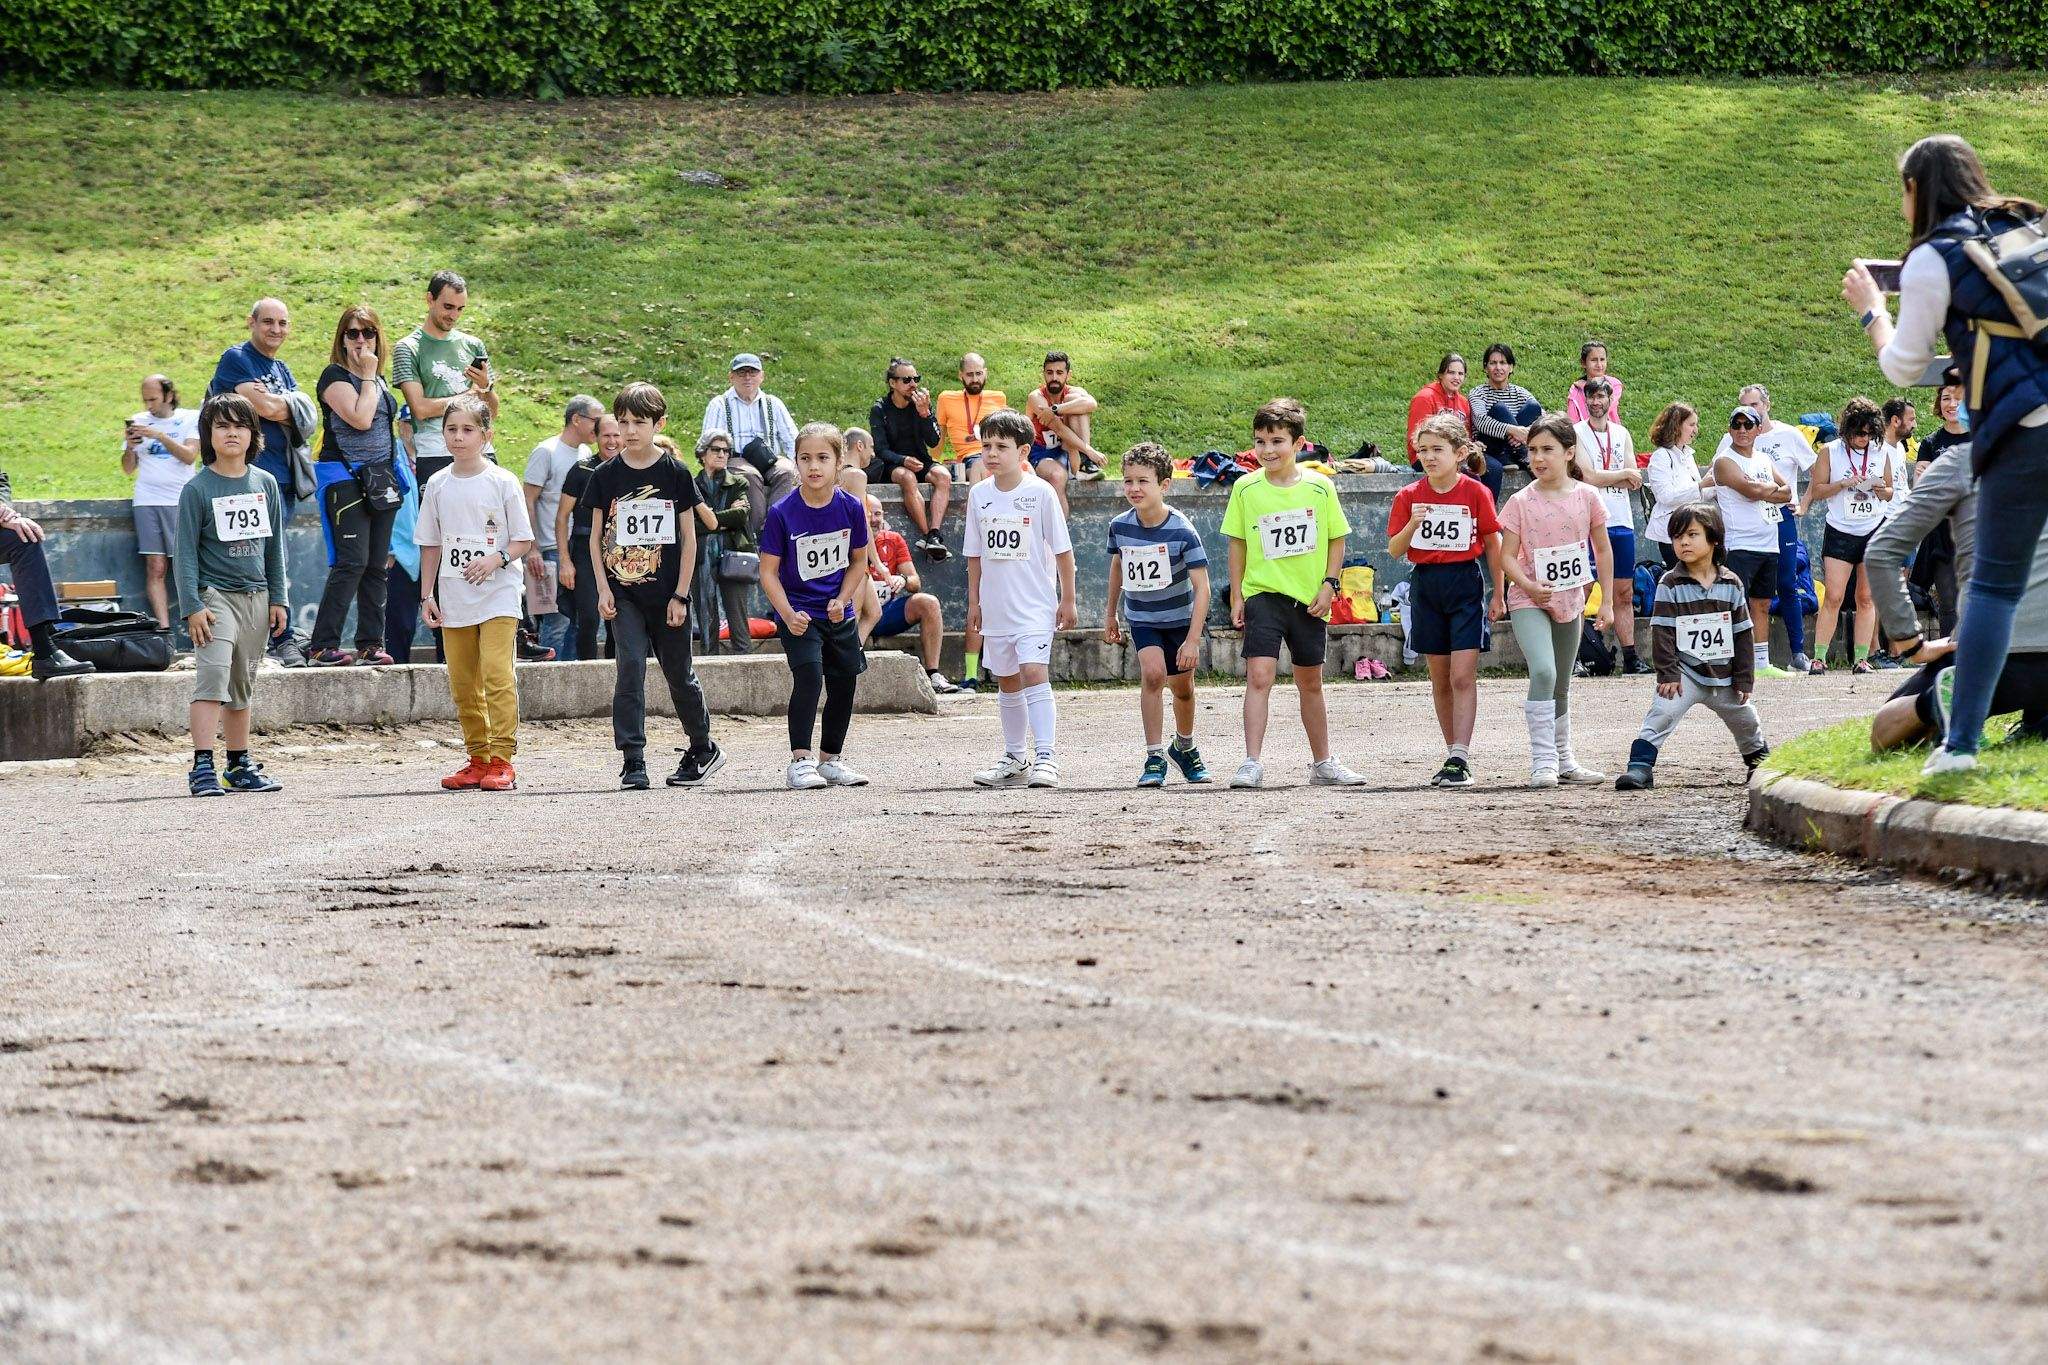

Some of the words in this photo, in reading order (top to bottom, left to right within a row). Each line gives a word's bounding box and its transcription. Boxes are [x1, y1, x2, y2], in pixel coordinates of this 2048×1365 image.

[1850, 502, 1873, 514] 749
[225, 508, 260, 530] 793
[626, 515, 664, 535] 817
[987, 529, 1021, 549] 809
[1270, 524, 1308, 548] 787
[1421, 520, 1460, 540] 845
[450, 548, 485, 569] 83
[806, 544, 841, 569] 911
[1128, 561, 1161, 581] 812
[1546, 557, 1582, 581] 856
[1687, 627, 1725, 650] 794
